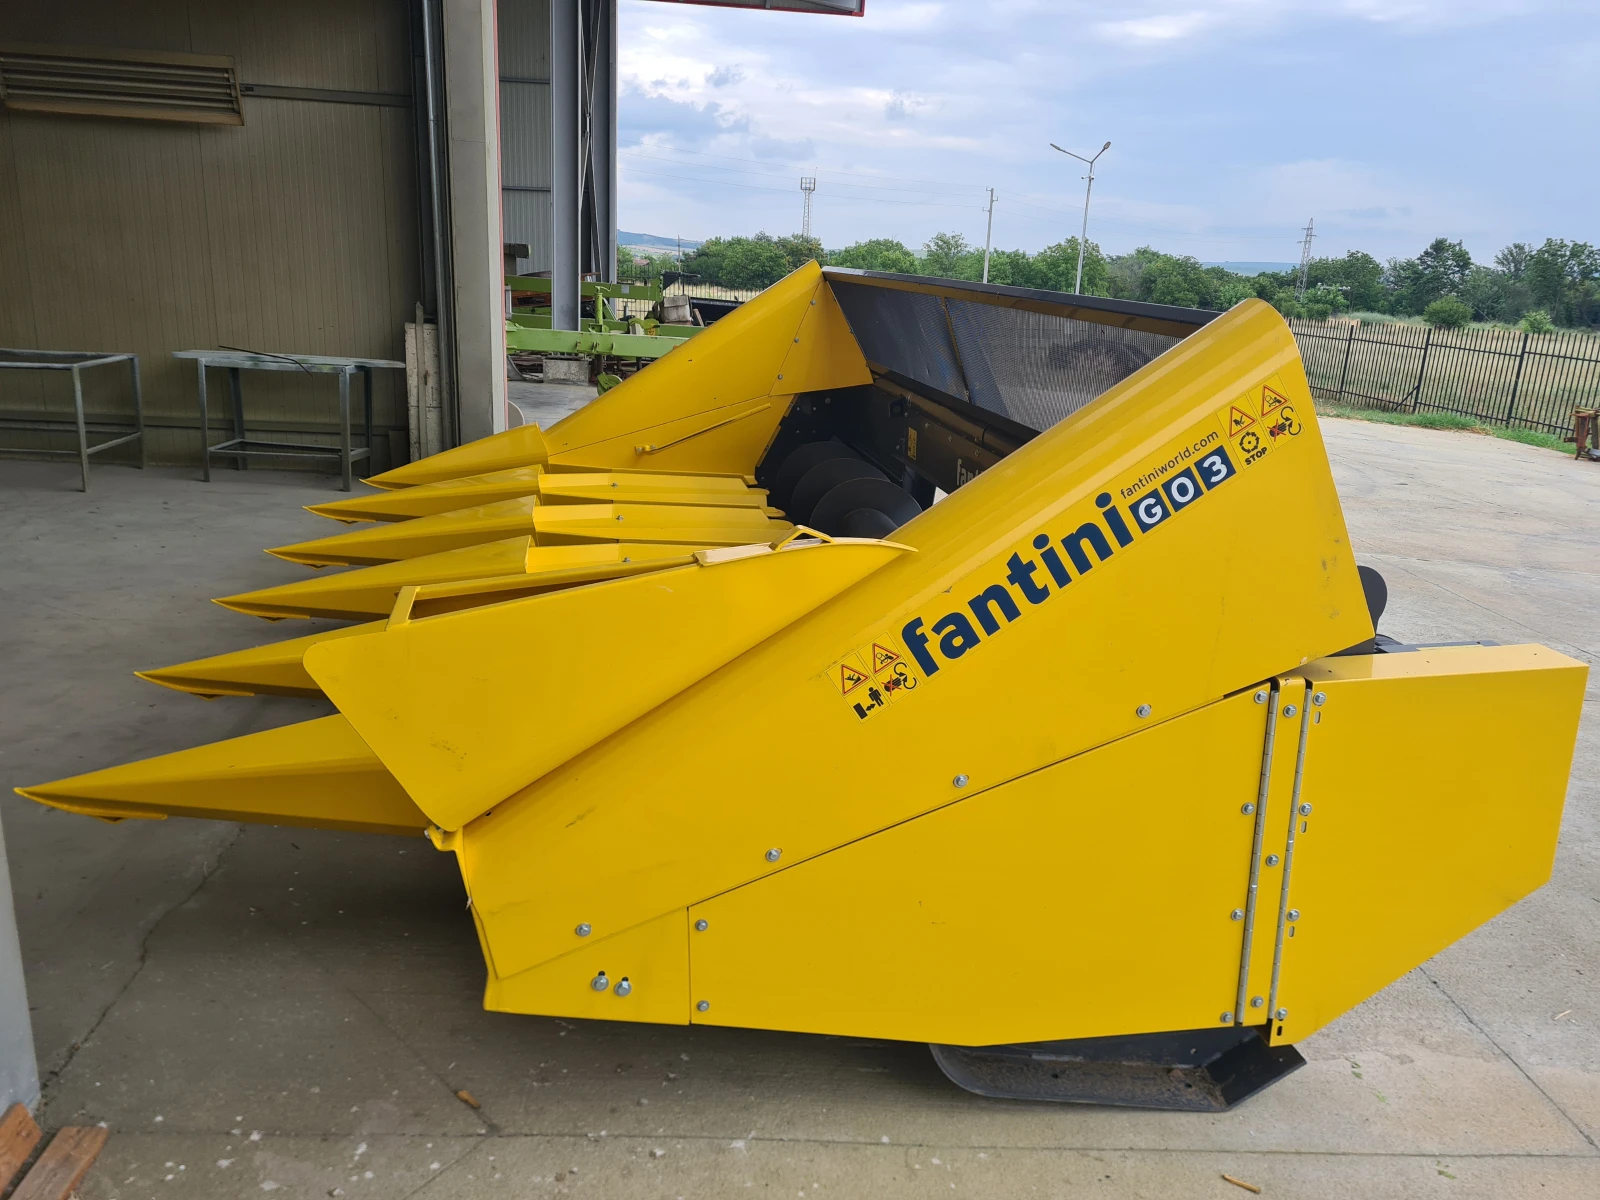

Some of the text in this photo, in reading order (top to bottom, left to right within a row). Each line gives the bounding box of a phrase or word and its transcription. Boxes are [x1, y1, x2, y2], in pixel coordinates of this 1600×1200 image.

[1120, 431, 1219, 499] fantiniworld.com
[1244, 446, 1268, 466] STOP
[901, 491, 1135, 678] fantini
